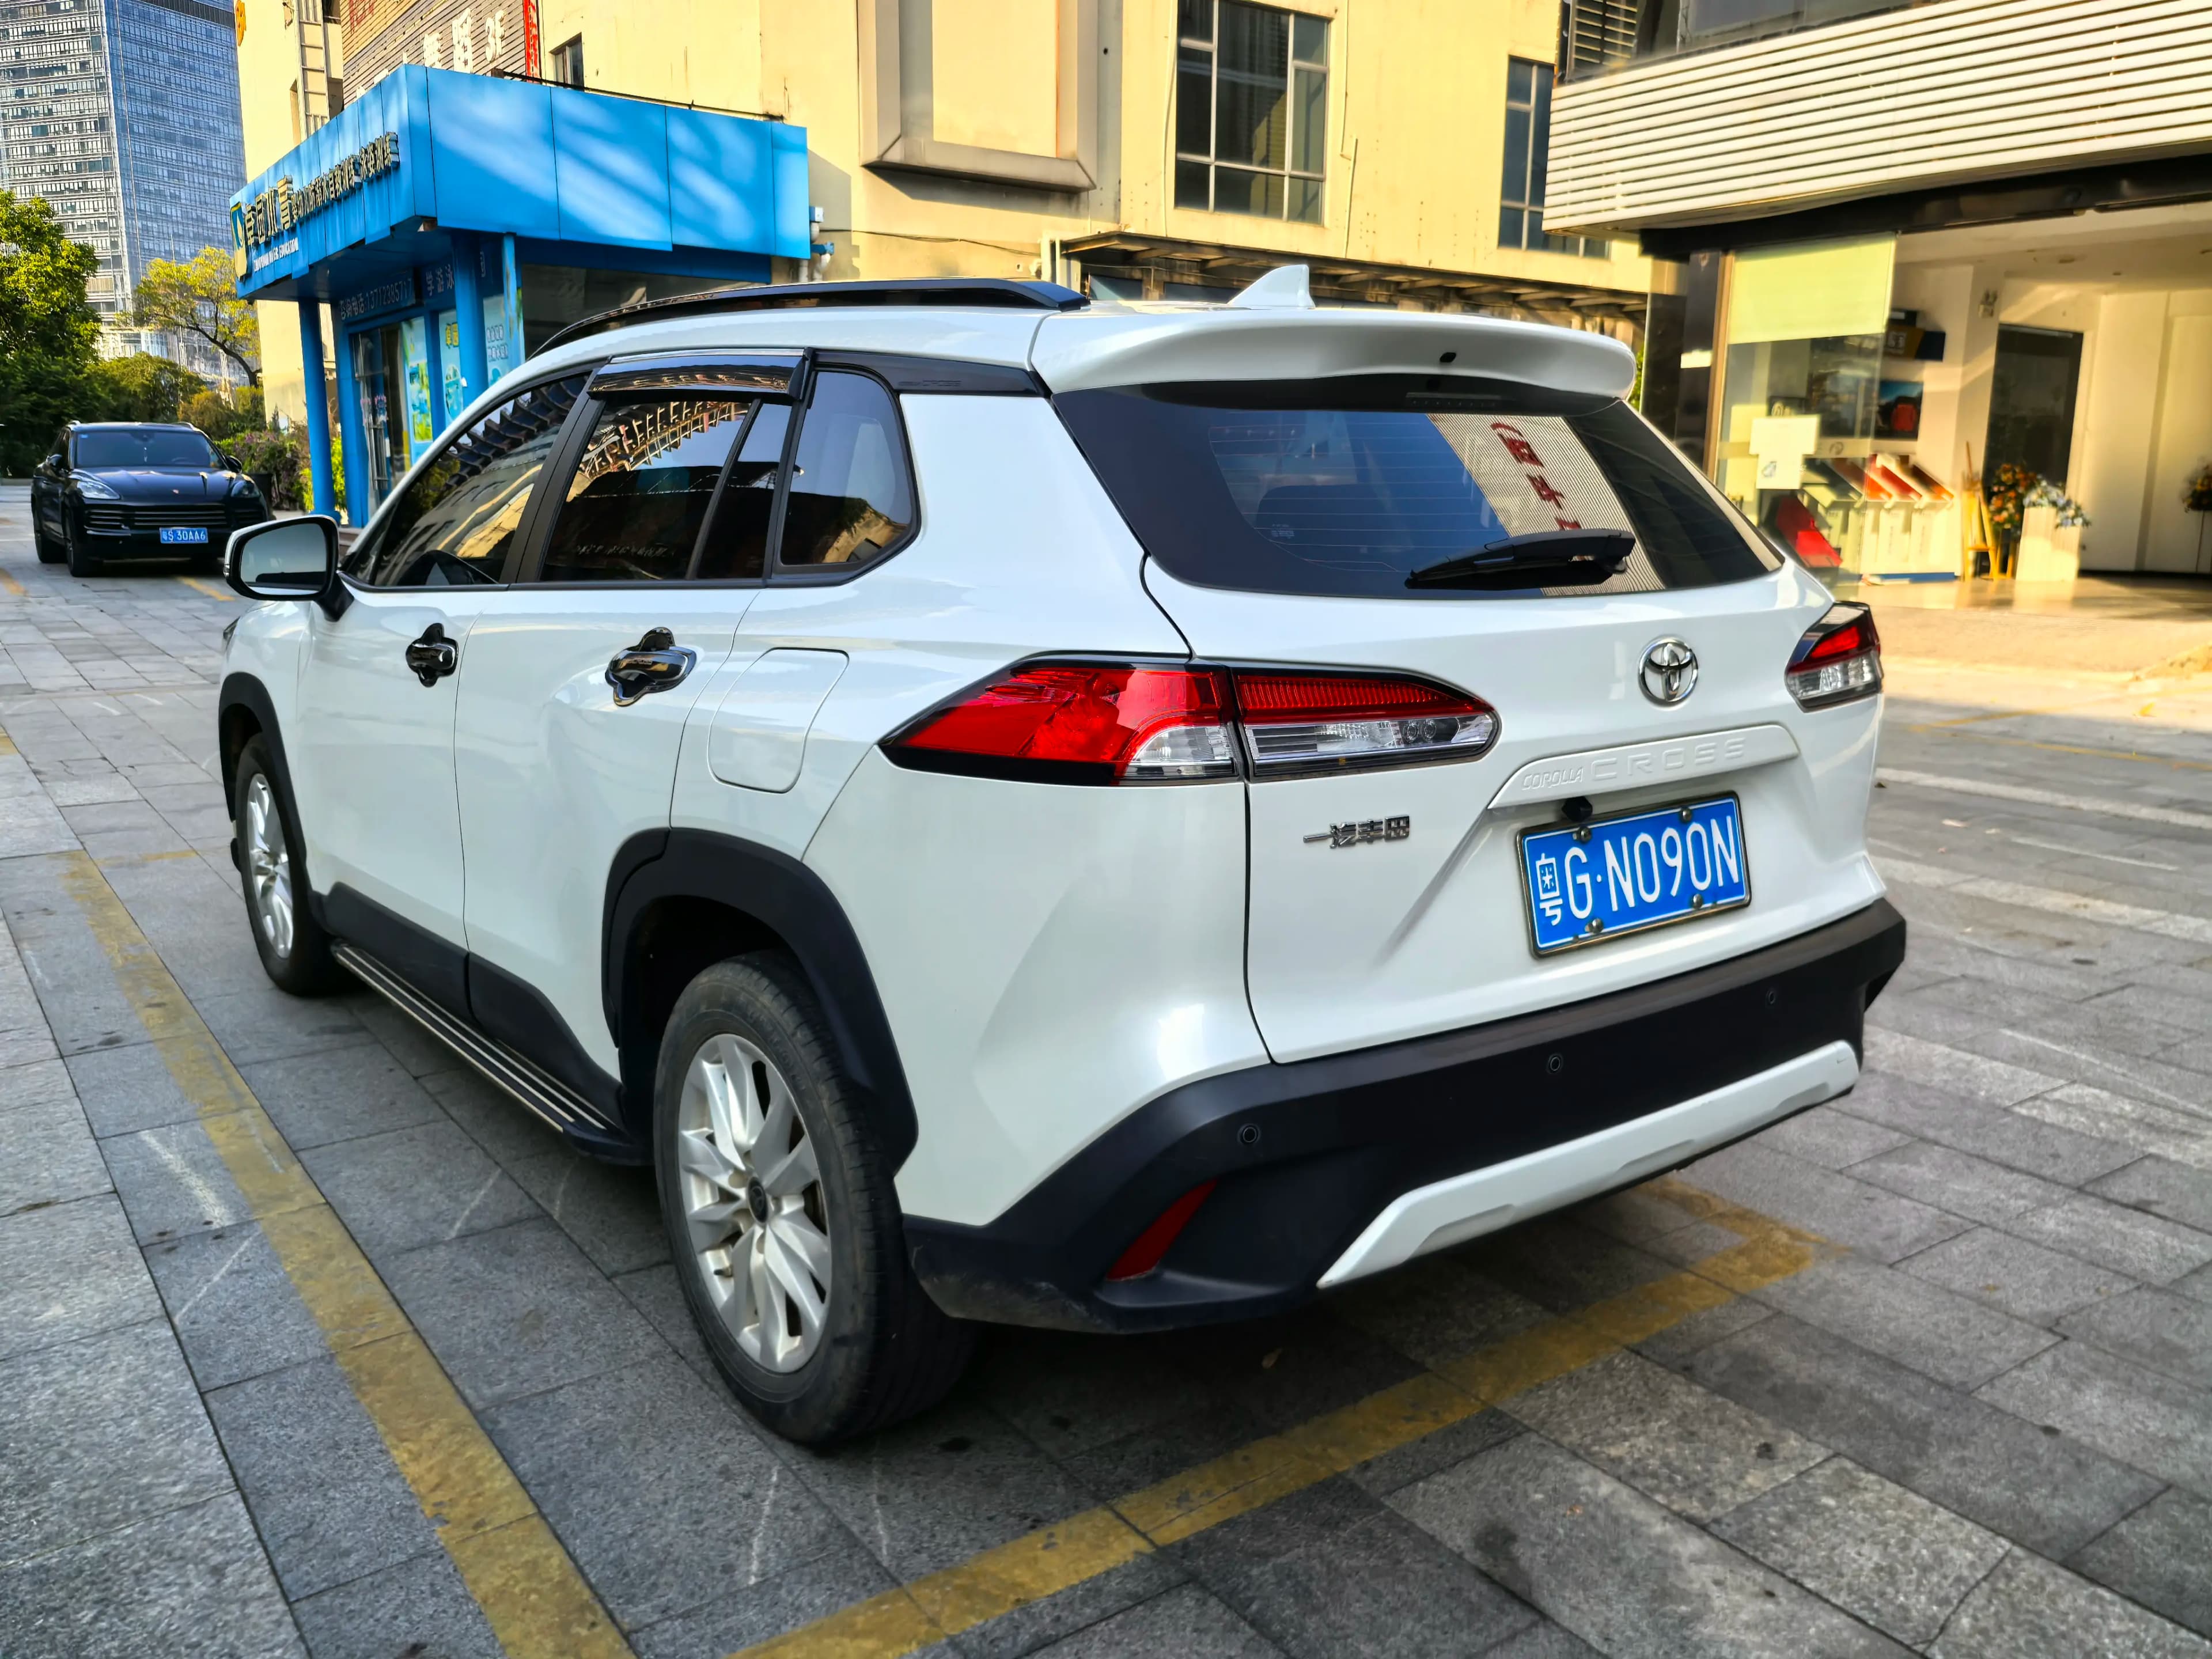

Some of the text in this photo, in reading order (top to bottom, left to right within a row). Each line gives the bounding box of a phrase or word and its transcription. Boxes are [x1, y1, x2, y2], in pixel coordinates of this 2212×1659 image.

[1522, 737, 1747, 791] COROLLA CROSS
[1303, 814, 1410, 849] 一汽丰田
